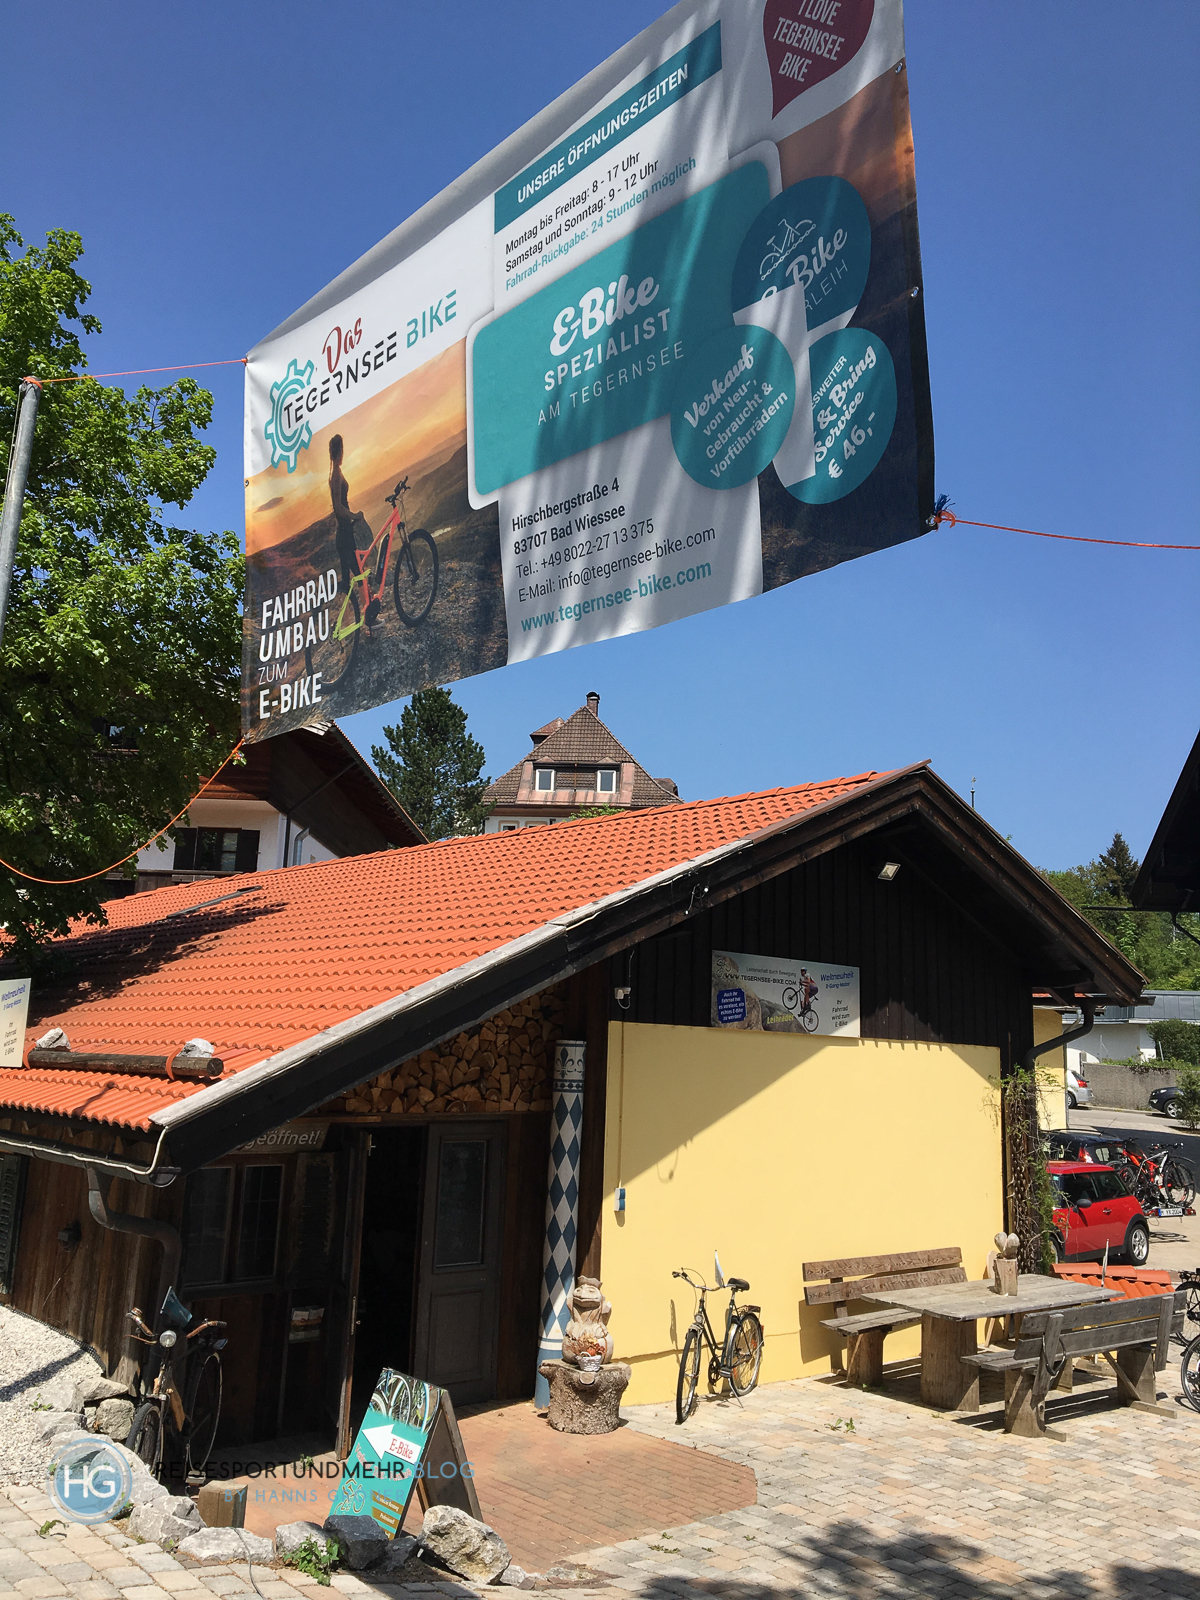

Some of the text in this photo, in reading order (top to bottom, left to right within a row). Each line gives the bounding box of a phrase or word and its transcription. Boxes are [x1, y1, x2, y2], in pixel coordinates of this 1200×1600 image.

[773, 17, 845, 61] TEGERNSEE
[804, 0, 842, 26] LOVE
[778, 52, 812, 82] BIKE
[517, 63, 688, 204] UNSERE ÖFFNUNGSZEITEN
[505, 225, 538, 255] Montag
[539, 214, 553, 231] bis
[555, 188, 590, 220] Freitag:
[592, 180, 599, 193] 8
[607, 164, 619, 182] 17
[621, 152, 640, 172] Uhr
[505, 240, 544, 273] Samstag
[545, 223, 562, 246] und
[564, 196, 606, 232] Sonntag:
[608, 188, 615, 201] 9
[624, 173, 637, 190] 12
[639, 160, 659, 180] Uhr
[506, 156, 697, 291] Fahrrad-Rückgabe: 24 Stunden möglich
[322, 317, 363, 374] Das
[544, 307, 671, 391] SPEZIALIST
[549, 274, 660, 356] E-Bike
[283, 289, 457, 429] TEGERNSEE BIKE
[537, 340, 684, 426] AM TEGERNSEE
[684, 344, 754, 428] Verkauf
[817, 345, 877, 430] & Bring
[703, 379, 757, 436] von Neu-,
[705, 382, 773, 459] Gebraucht &
[710, 392, 788, 478] Vorführrädern
[814, 391, 864, 463] Service
[828, 458, 844, 479] €
[511, 477, 620, 532] Hirschbergstraße 4
[513, 504, 626, 555] 83707 Bad Wiessee
[516, 518, 655, 579] Tel.: +49 8022-27 13 375
[518, 527, 716, 603] E-Mail: info@tegernsee-bike.com
[261, 568, 338, 630] FAHRRAD
[521, 562, 712, 632] www.tegernsee-bike.com
[259, 608, 330, 663] UMBAU
[257, 661, 288, 686] ZUM
[259, 672, 323, 720] E-BIKE
[389, 1438, 413, 1459] E-Bike
